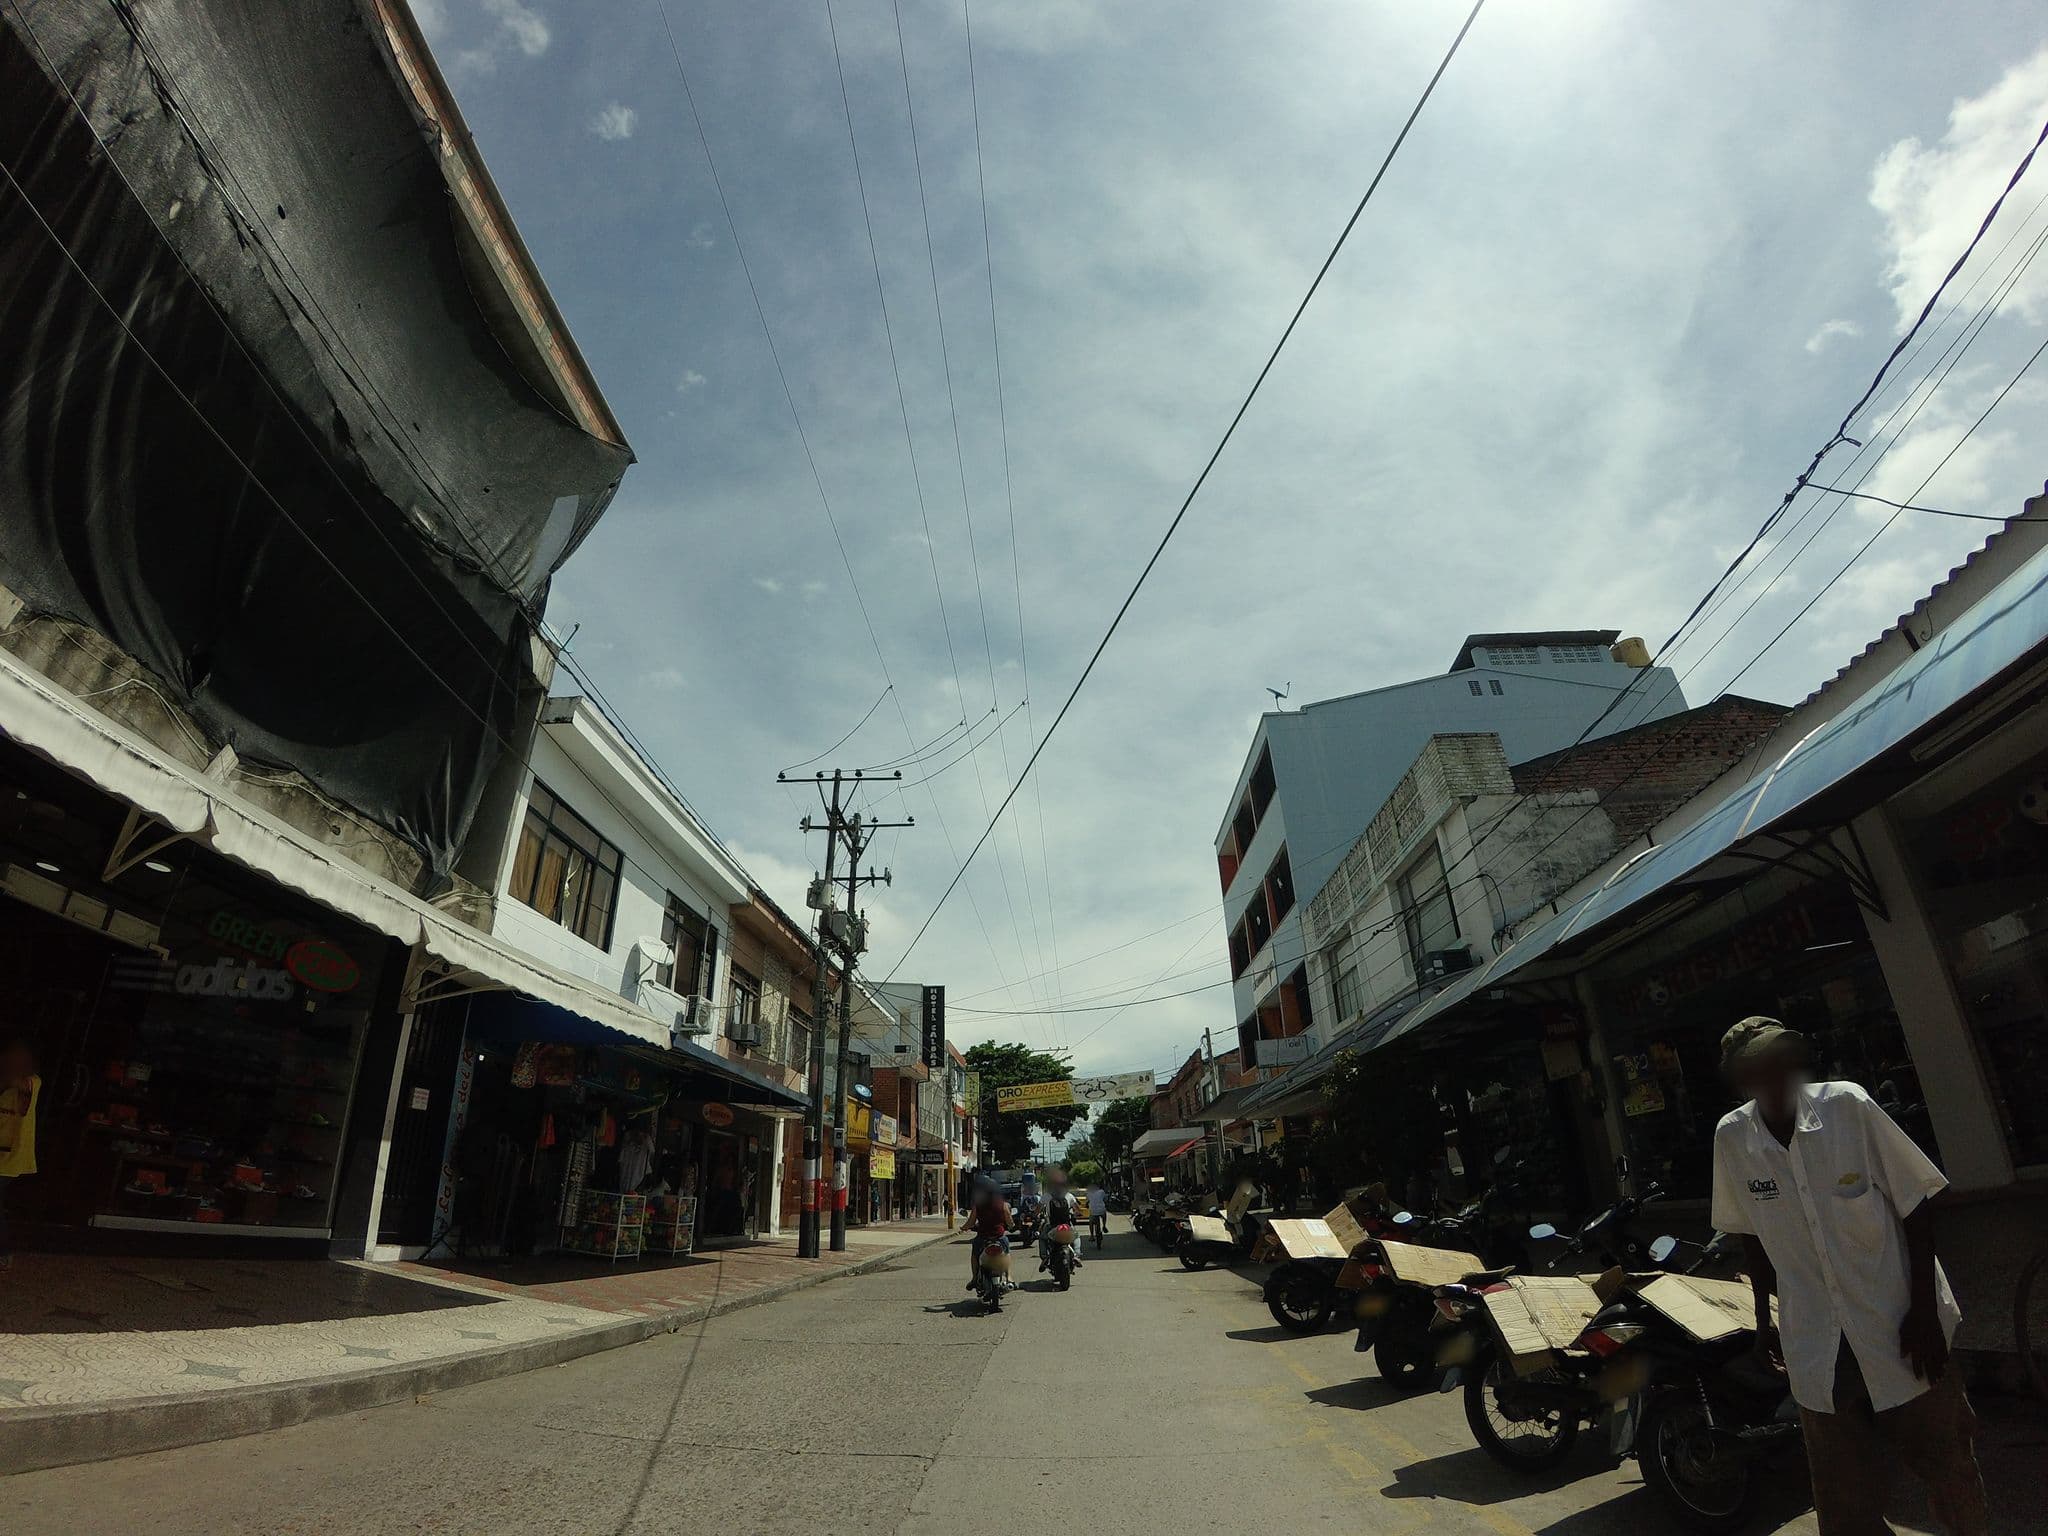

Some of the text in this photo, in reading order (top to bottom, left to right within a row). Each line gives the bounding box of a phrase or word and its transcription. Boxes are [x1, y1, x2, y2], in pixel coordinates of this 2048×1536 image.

[929, 988, 938, 1066] HOTEL CALDAS
[998, 1082, 1068, 1099] ORO EXPRESS
